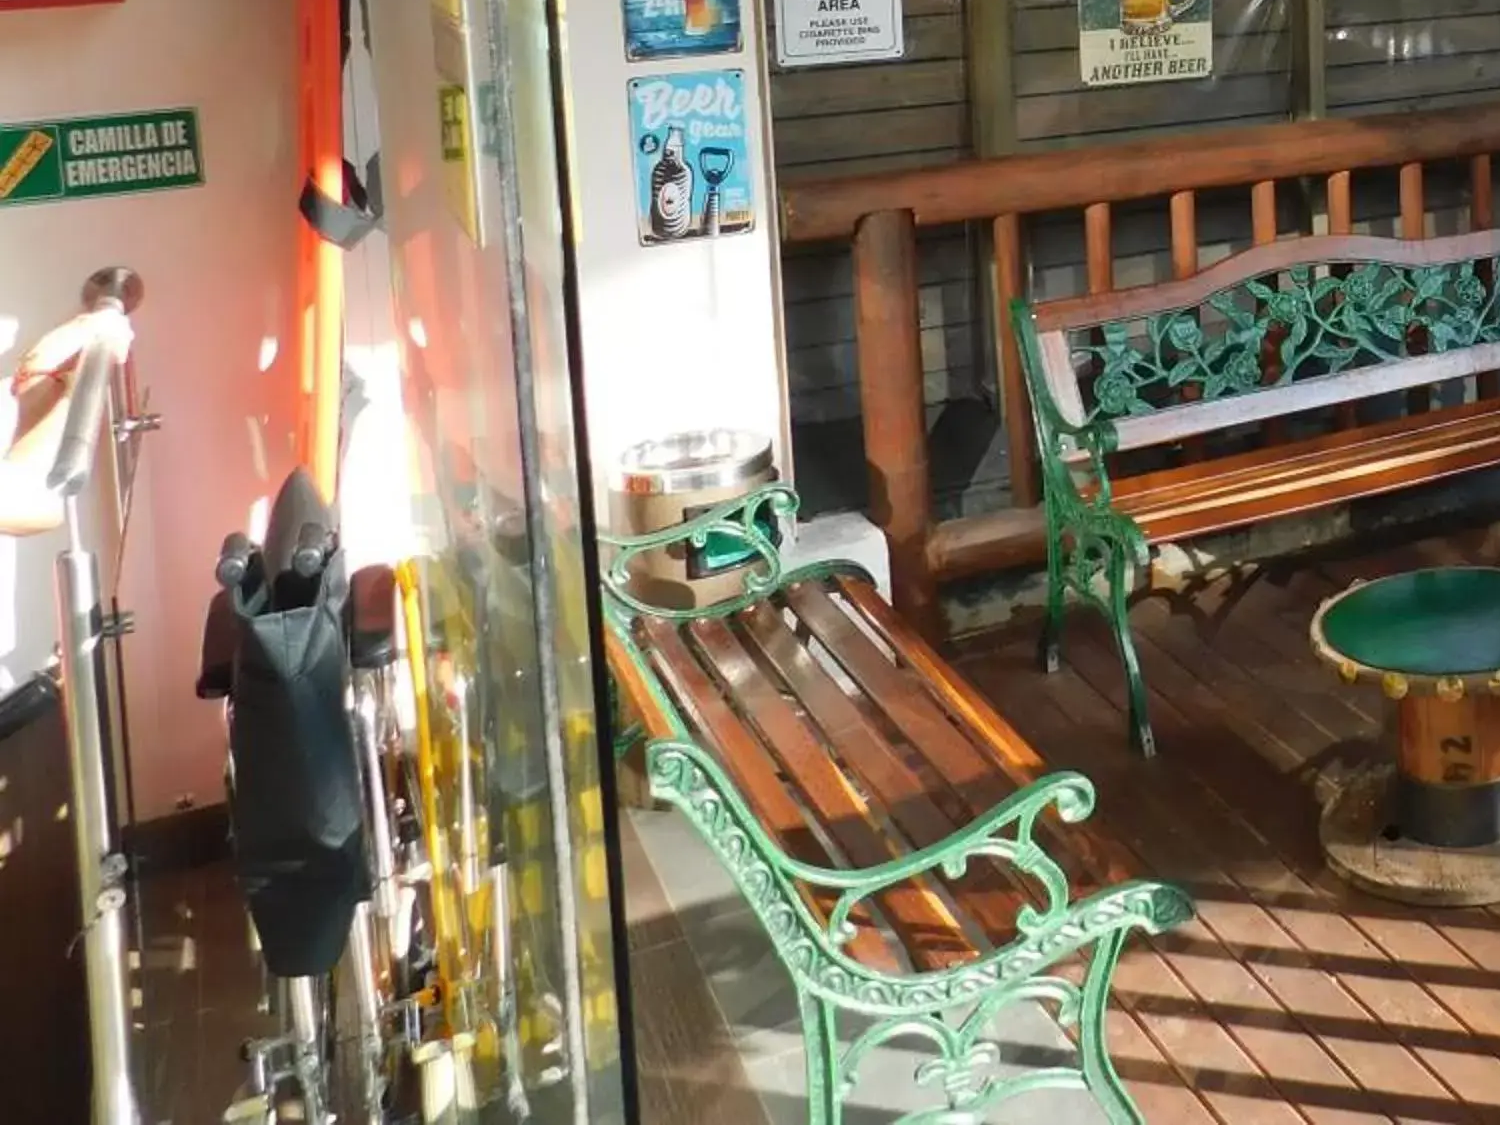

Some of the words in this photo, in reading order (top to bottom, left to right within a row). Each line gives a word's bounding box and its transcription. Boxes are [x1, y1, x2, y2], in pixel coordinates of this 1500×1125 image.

[799, 28, 855, 39] CIGARETTE
[809, 17, 847, 28] PLEASE
[849, 16, 869, 26] USE
[815, 36, 866, 47] PROVIDED
[1089, 60, 1164, 82] ANOTHER
[1168, 58, 1207, 75] BEER
[636, 77, 744, 129] Beer
[68, 123, 158, 156] CAMILLA
[161, 119, 188, 145] DE
[65, 148, 197, 188] EMERGENCIA
